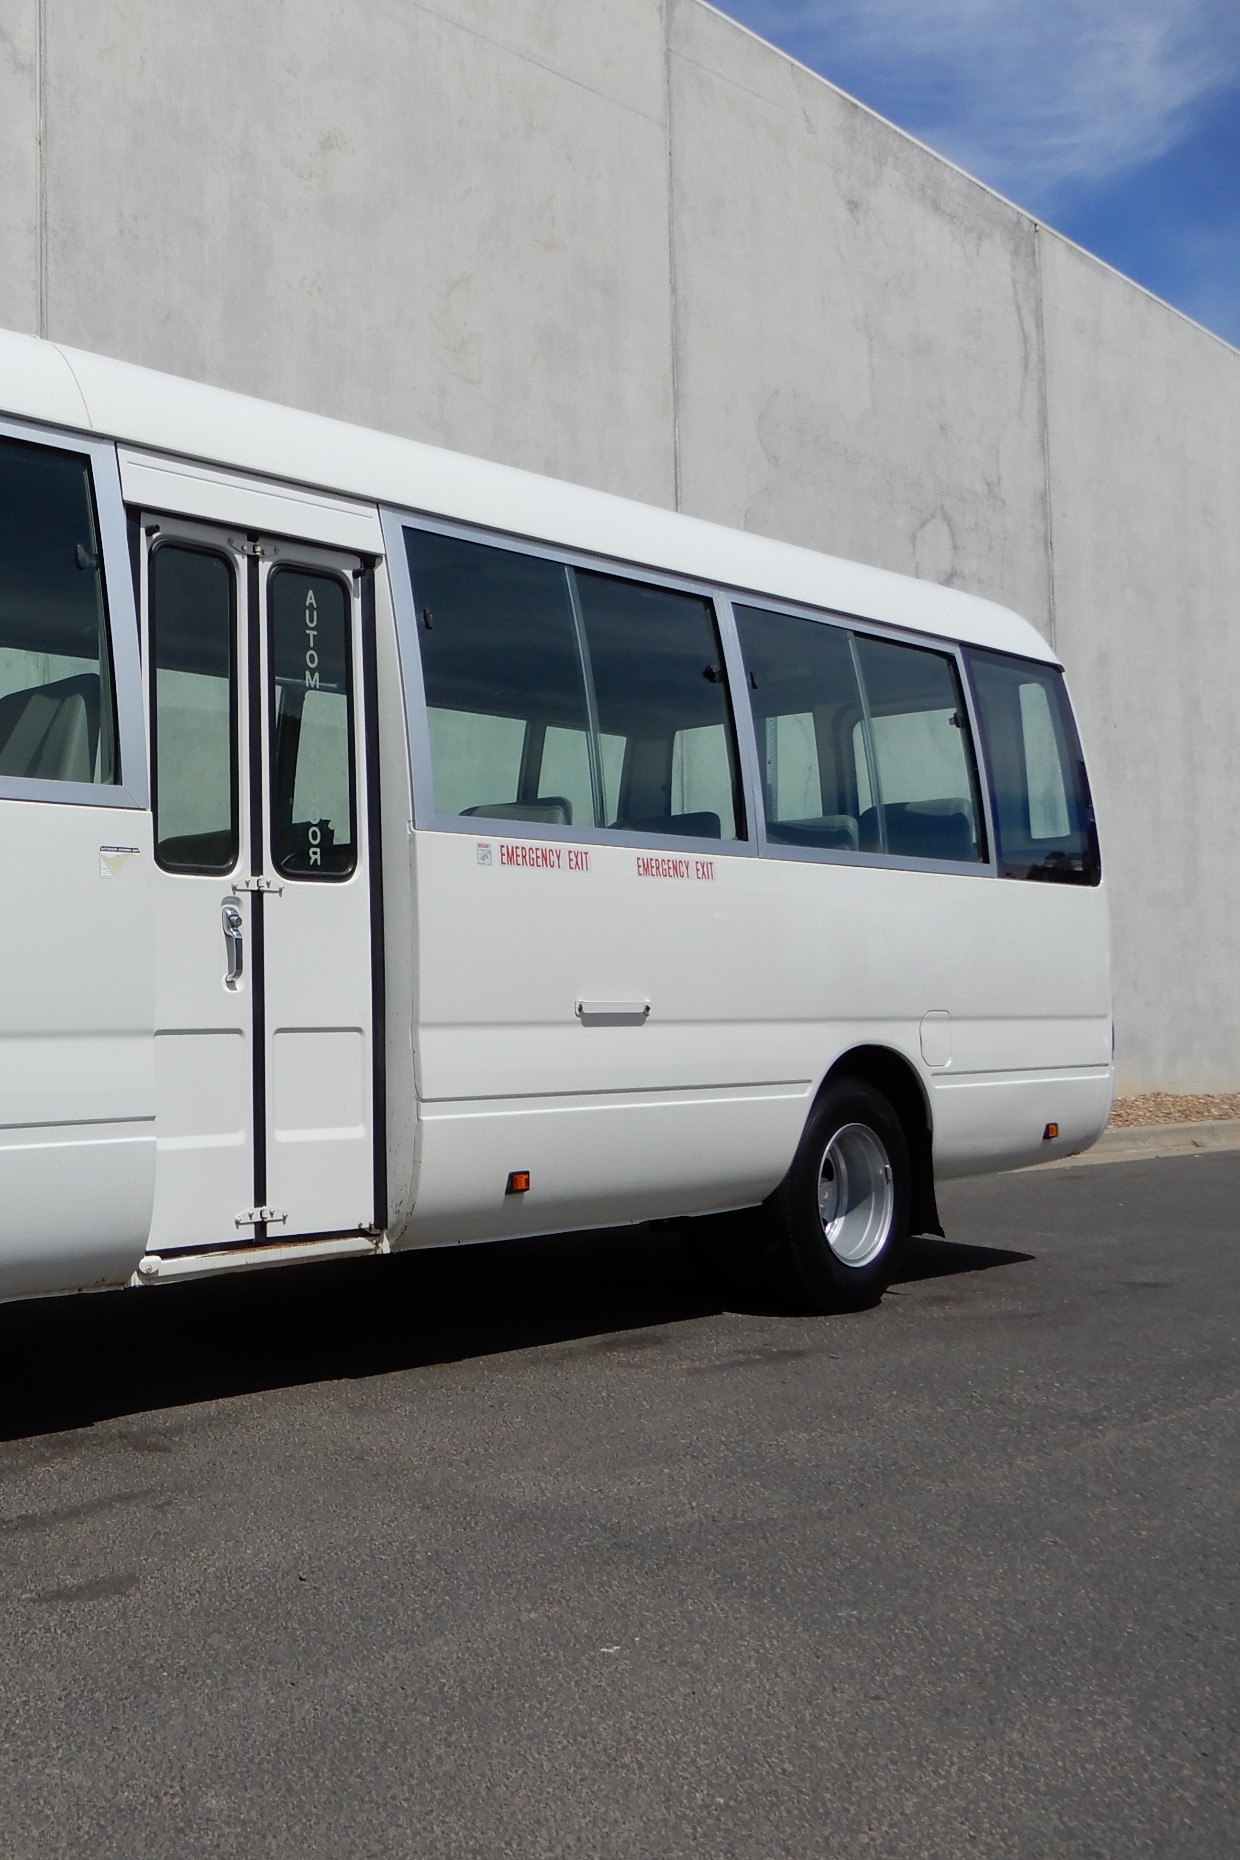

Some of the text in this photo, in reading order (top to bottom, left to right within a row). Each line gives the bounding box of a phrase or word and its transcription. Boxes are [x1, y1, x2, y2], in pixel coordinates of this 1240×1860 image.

[500, 845, 589, 871] EMERGENCY EXIT
[637, 857, 714, 881] EMERGENCY EXIT
